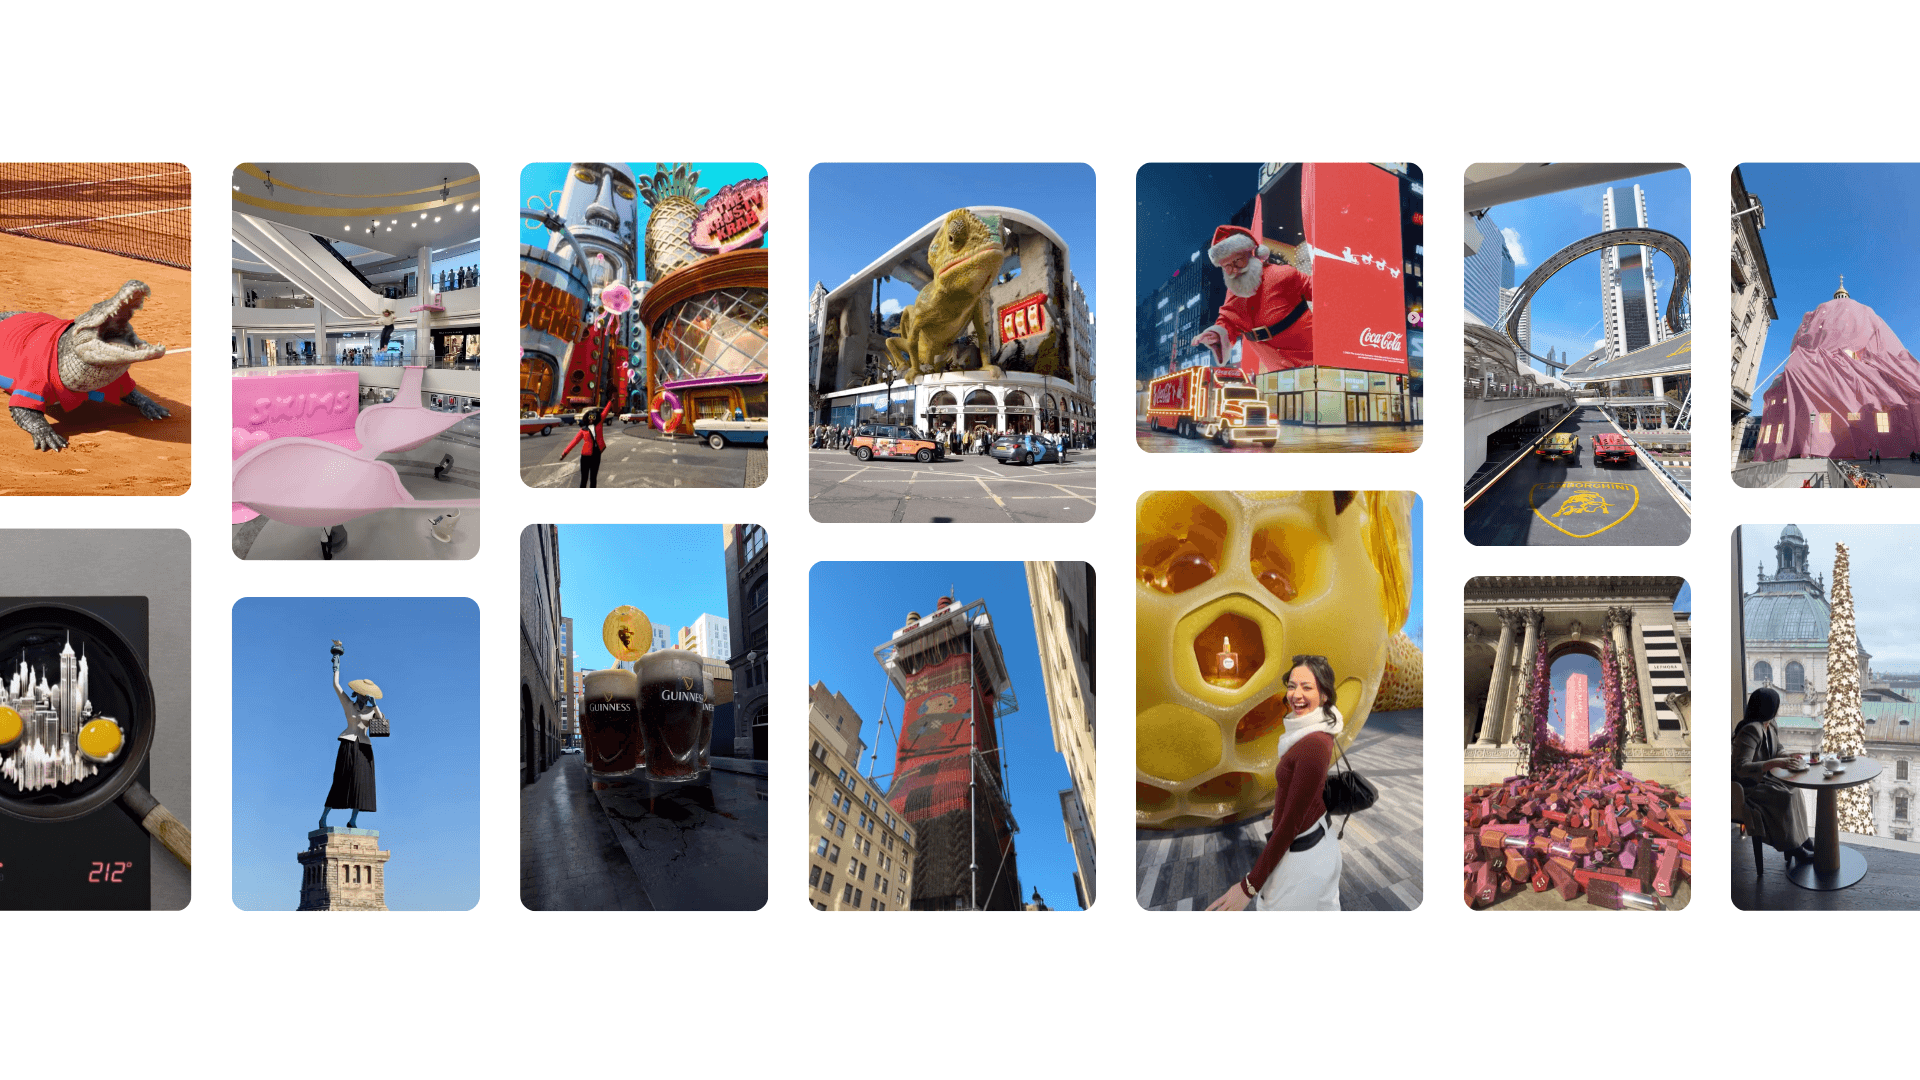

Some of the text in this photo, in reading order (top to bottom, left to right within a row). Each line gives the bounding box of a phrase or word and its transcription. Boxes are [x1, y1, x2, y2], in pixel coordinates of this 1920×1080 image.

[707, 191, 763, 236] KRUSTY
[716, 192, 743, 214] THE
[716, 210, 759, 241] KRAB
[1359, 327, 1403, 351] Coca-Cola
[248, 391, 351, 426] SKIMS
[1540, 482, 1630, 491] LAMBORGHINI
[589, 703, 631, 712] GUINNESS
